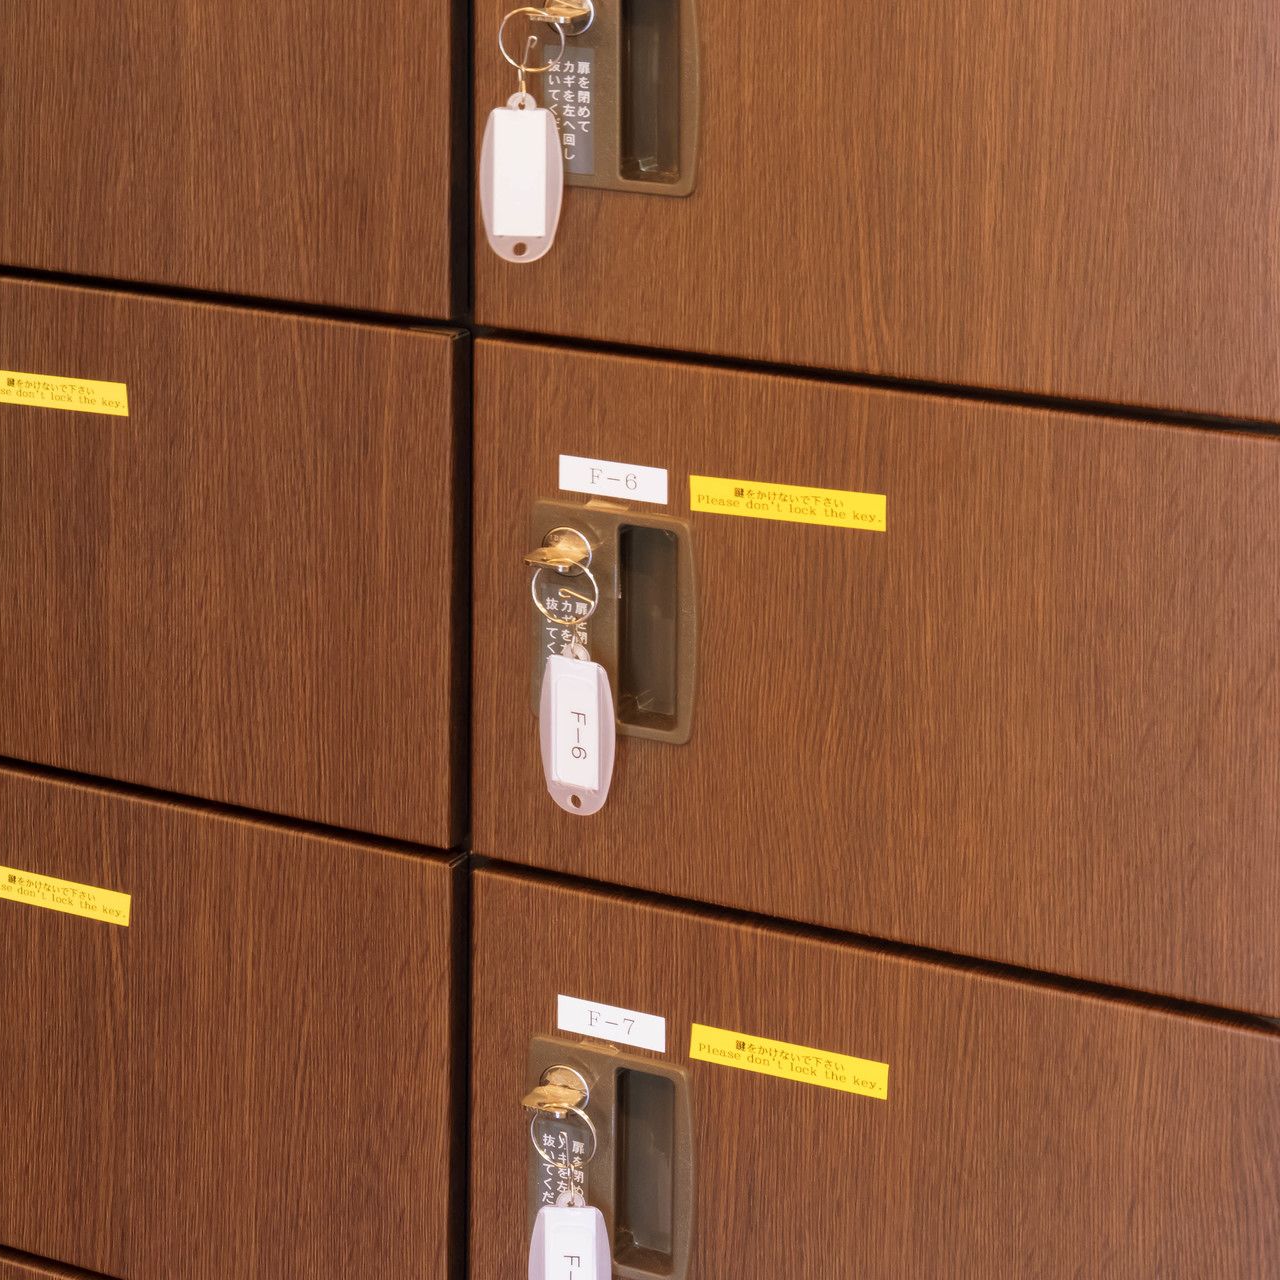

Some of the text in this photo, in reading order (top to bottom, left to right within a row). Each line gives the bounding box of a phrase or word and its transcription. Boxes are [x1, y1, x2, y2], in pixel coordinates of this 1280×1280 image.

[563, 61, 576, 161] カギを左へ回し
[577, 61, 591, 133] 扉を閉めて
[16, 388, 46, 399] don't
[50, 392, 75, 402] lock
[79, 395, 99, 405] the
[103, 397, 126, 409] key.
[589, 467, 638, 491] F-6
[697, 493, 883, 524] Please don't lock the key.
[734, 486, 845, 508] 鍵をかけないで下さい
[570, 710, 587, 760] F-6
[19, 886, 48, 900] don't
[53, 893, 77, 907] lock
[82, 900, 100, 912] the
[105, 905, 126, 919] key.
[587, 1009, 635, 1035] F-7
[698, 1042, 883, 1092] Please don't lock the key.
[735, 1040, 845, 1072] 鍵をかけないで下さい
[563, 1255, 581, 1280] F-
